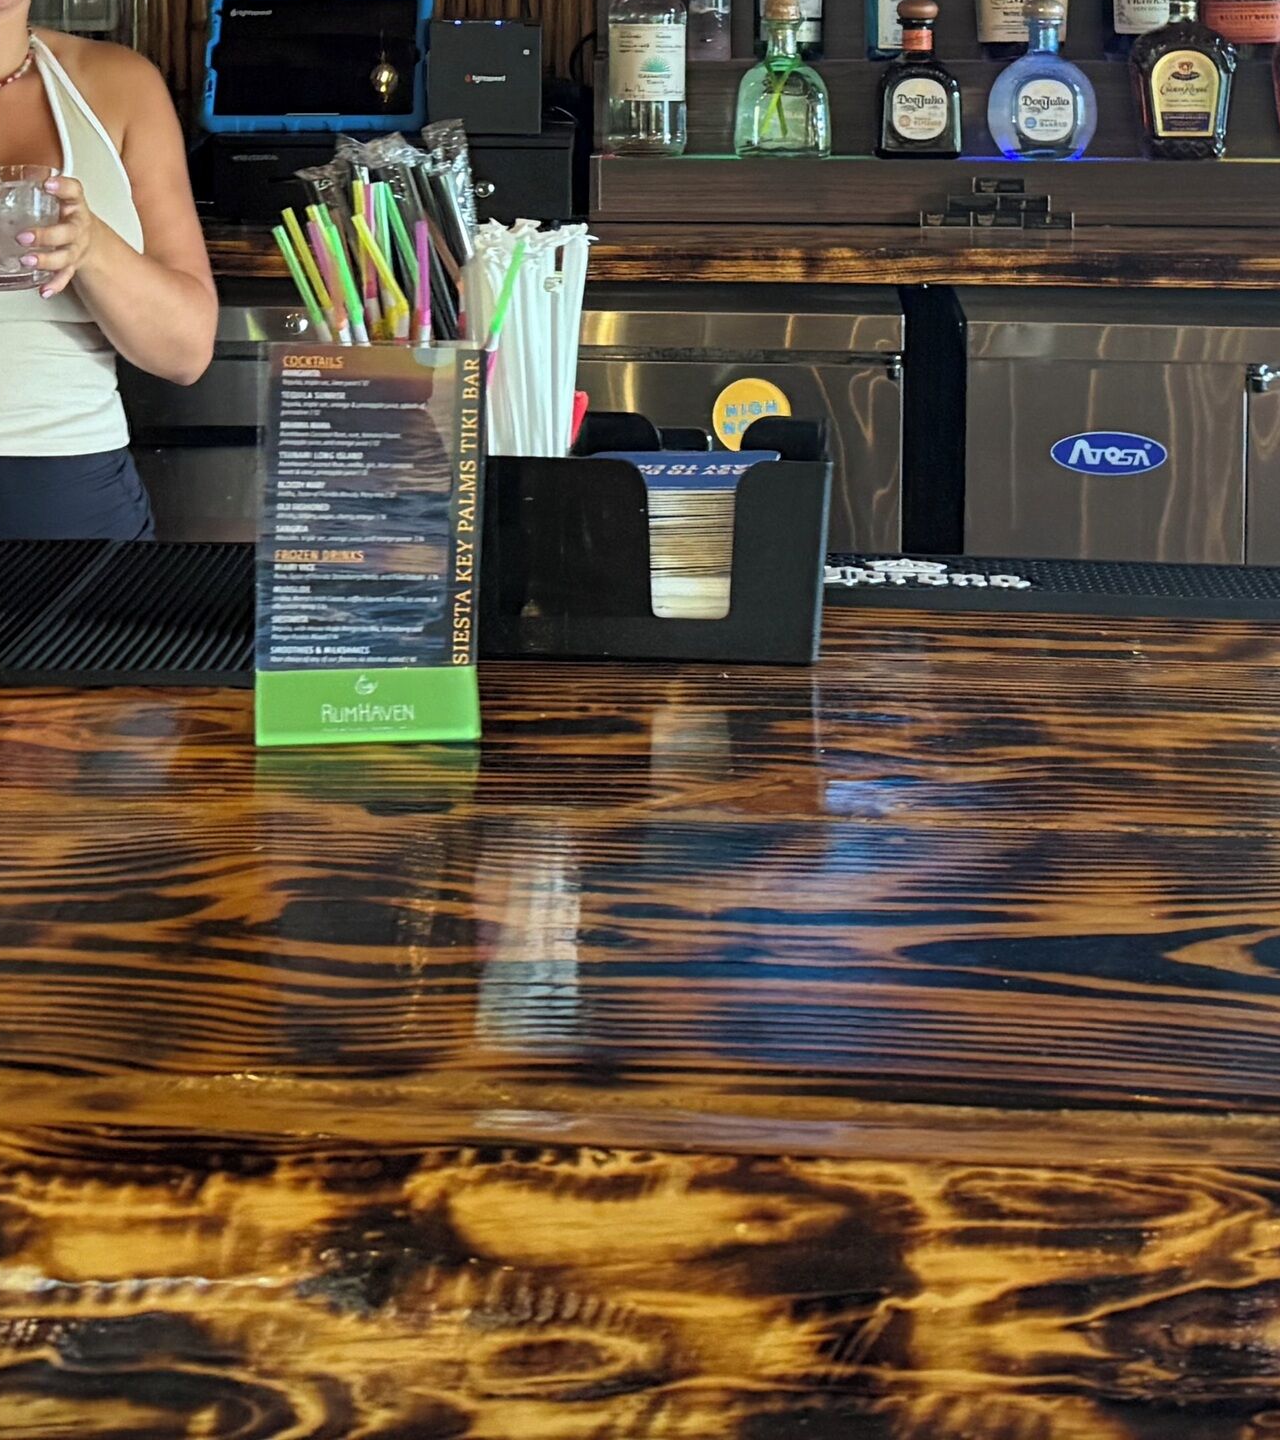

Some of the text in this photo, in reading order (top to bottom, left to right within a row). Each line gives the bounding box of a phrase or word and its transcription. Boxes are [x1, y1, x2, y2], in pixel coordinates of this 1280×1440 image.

[282, 355, 344, 368] COCKTAILS
[724, 400, 778, 418] HIGH
[452, 358, 481, 666] SIESTA KEY PALMS TIKI BAR
